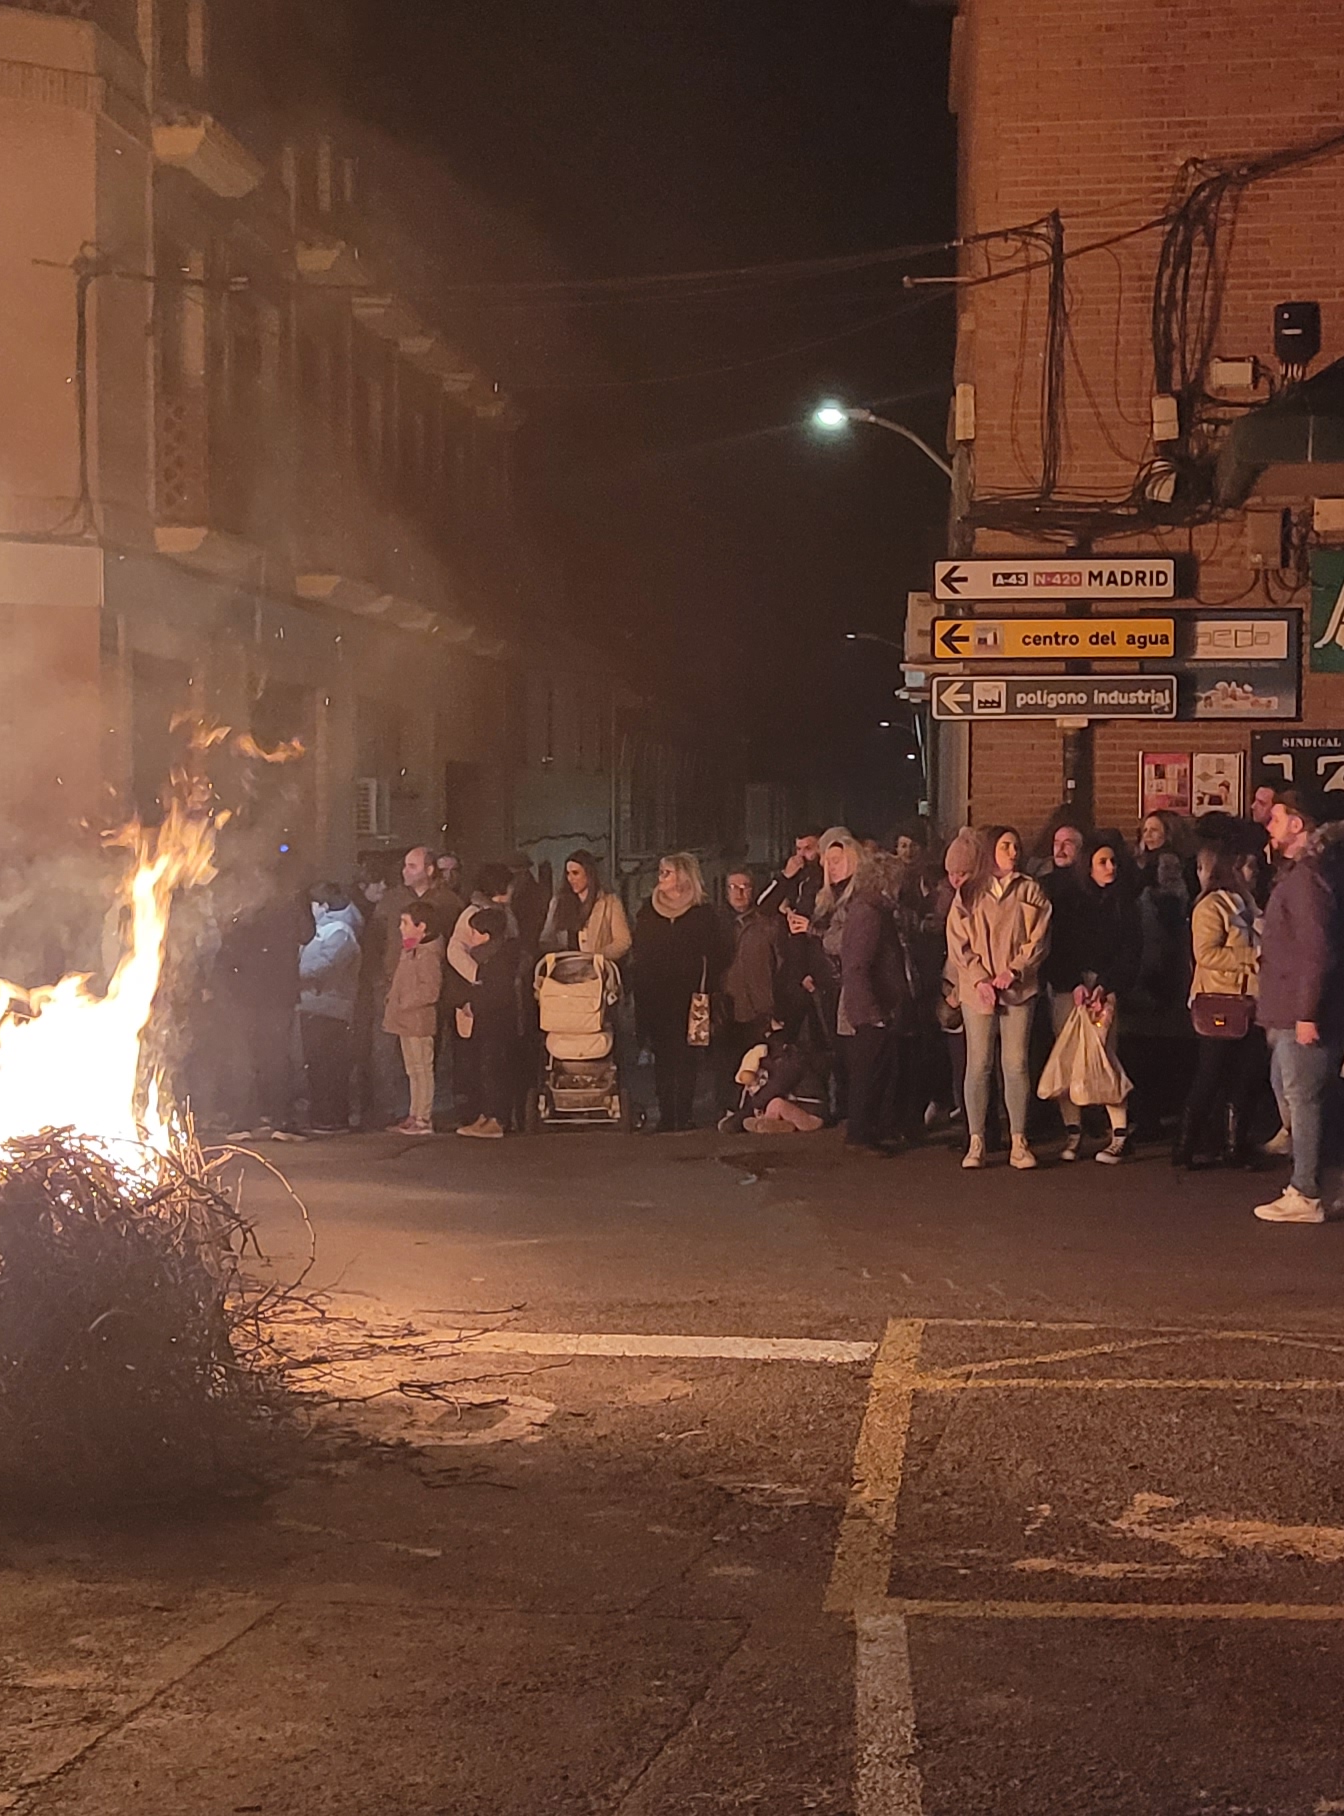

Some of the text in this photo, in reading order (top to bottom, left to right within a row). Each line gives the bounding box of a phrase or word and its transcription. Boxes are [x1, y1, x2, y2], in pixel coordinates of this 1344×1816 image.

[995, 570, 1168, 587] A-43 N-420 MADRID
[1022, 631, 1170, 649] centro del agua
[1015, 689, 1170, 708] polígono industrial
[1282, 737, 1342, 748] SINDICAL
